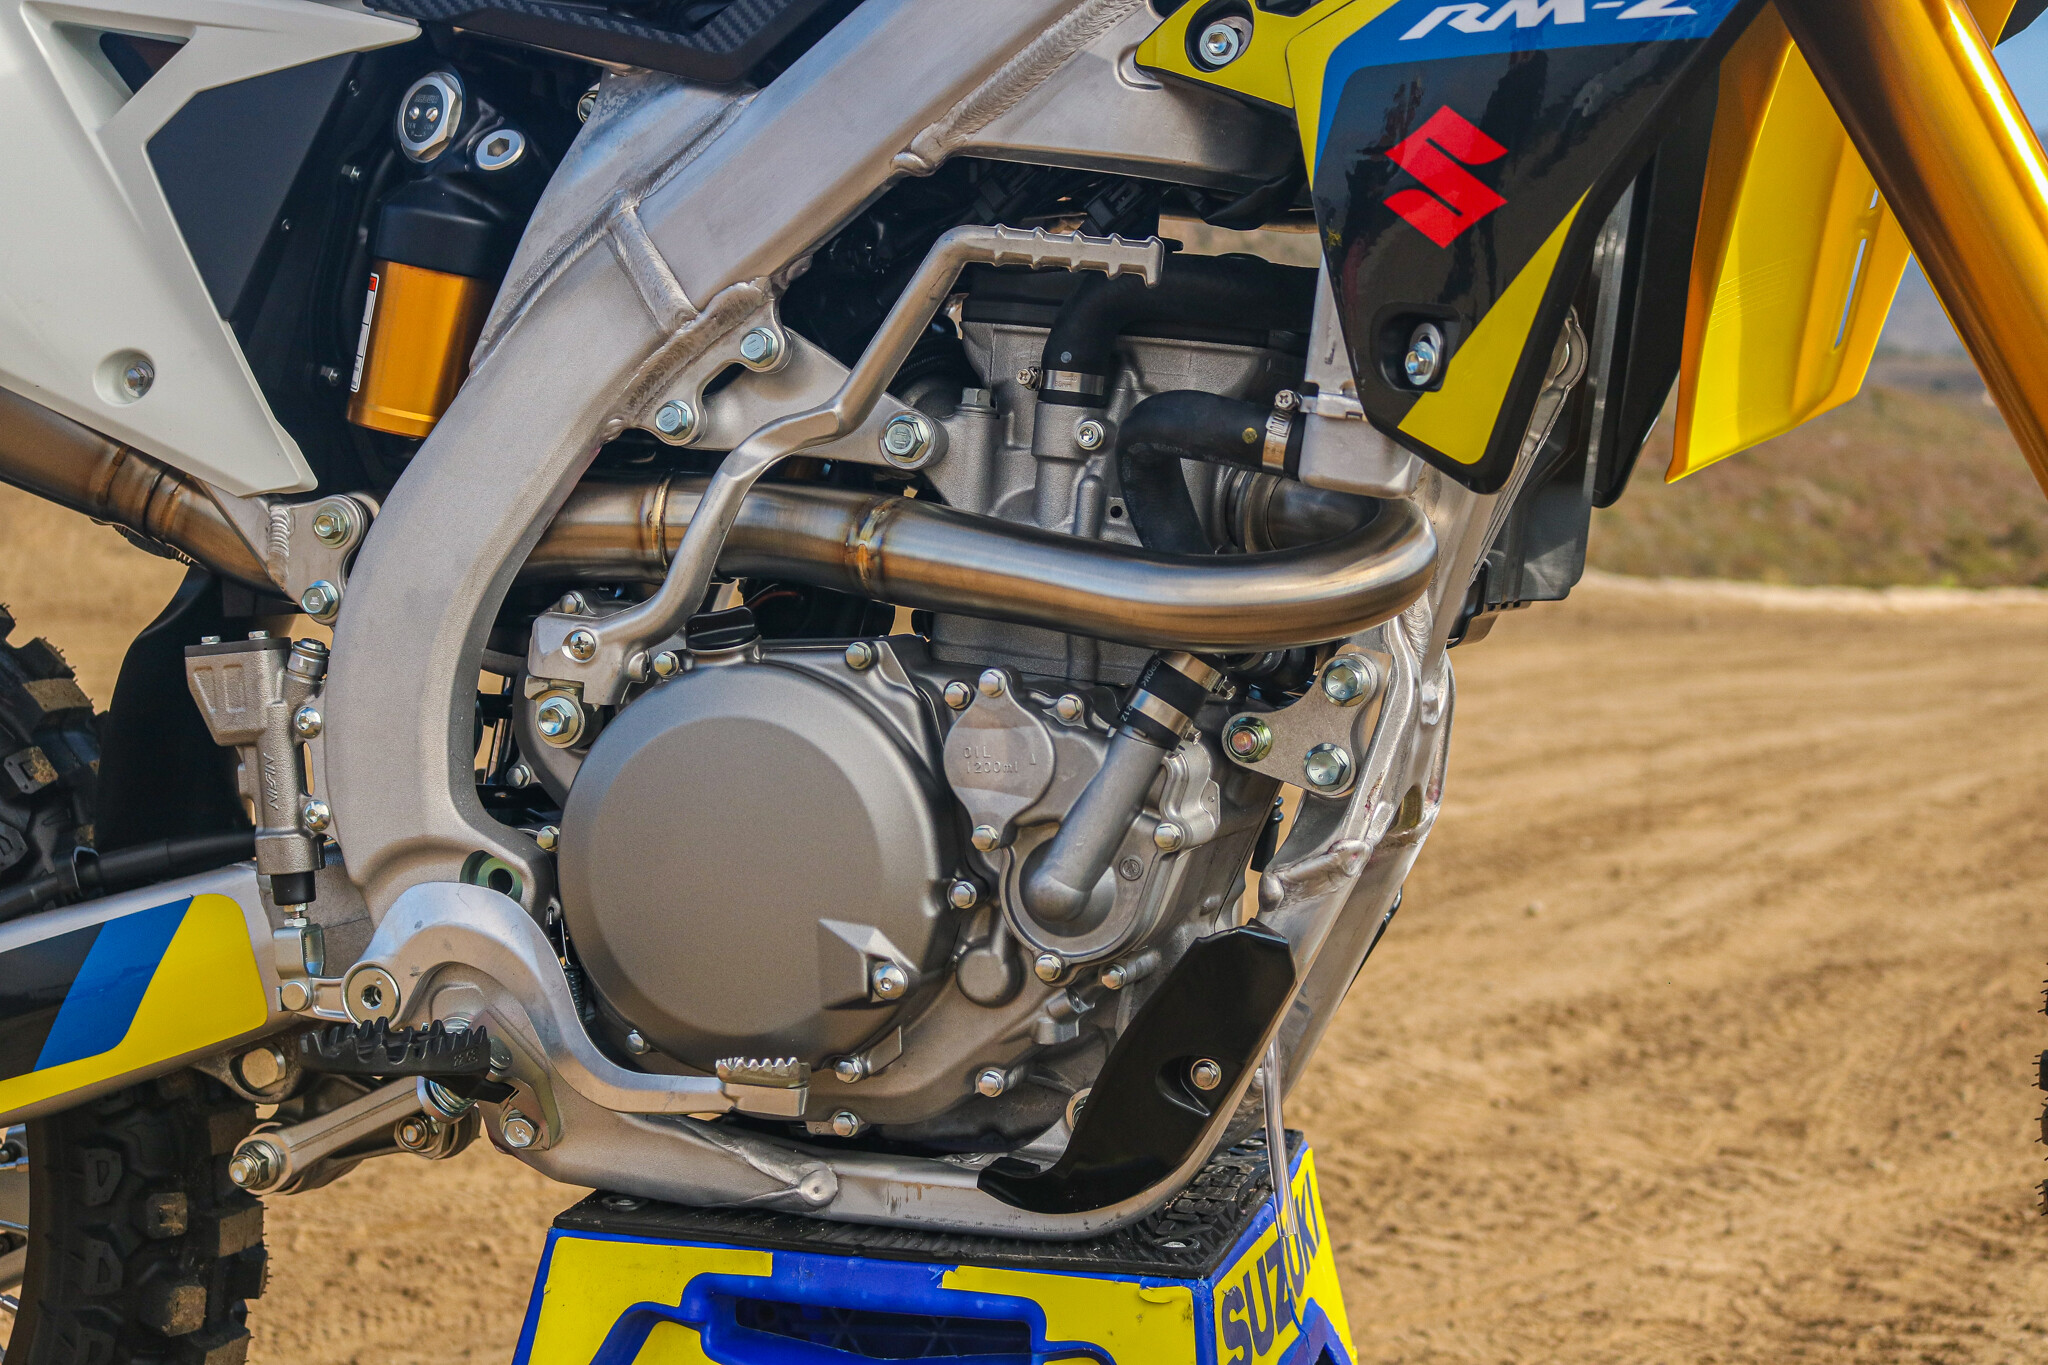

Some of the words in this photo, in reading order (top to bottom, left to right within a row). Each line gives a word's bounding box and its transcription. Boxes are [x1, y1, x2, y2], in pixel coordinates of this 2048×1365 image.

[963, 746, 991, 758] OIL
[966, 761, 1018, 774] 1200ml
[1222, 1170, 1321, 1365] SUZUKI
